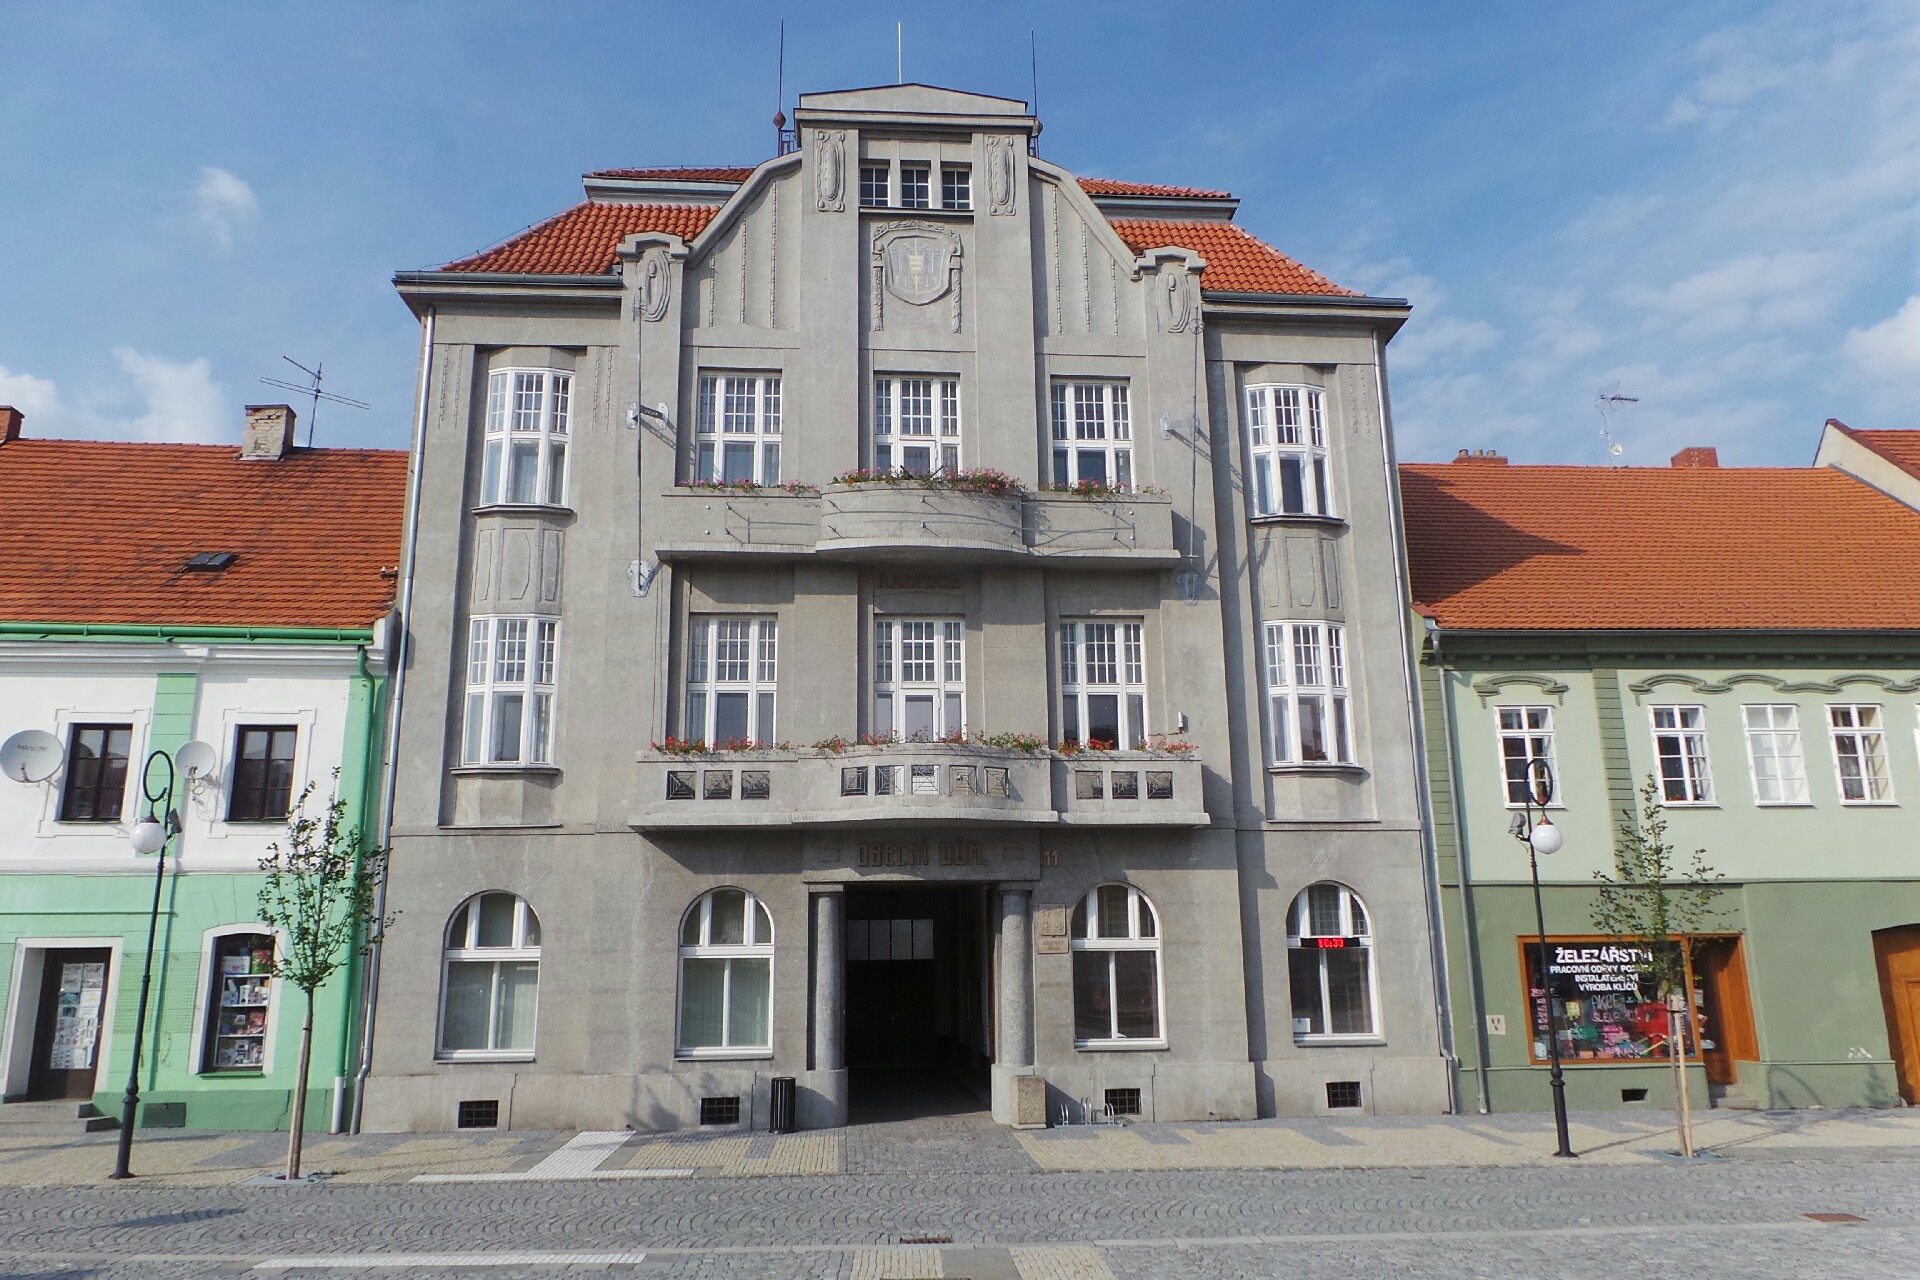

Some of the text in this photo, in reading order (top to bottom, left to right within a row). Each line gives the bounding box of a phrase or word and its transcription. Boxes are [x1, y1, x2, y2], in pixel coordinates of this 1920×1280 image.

[1043, 849, 1058, 867] 11
[1318, 938, 1344, 948] 16:33
[1555, 947, 1653, 963] ŽELEZÁŘSTVÍ
[1550, 964, 1589, 974] PRACOVNÍ
[1578, 982, 1638, 991] VÝROBA KLÍČŮ
[1591, 993, 1620, 1010] AKCE
